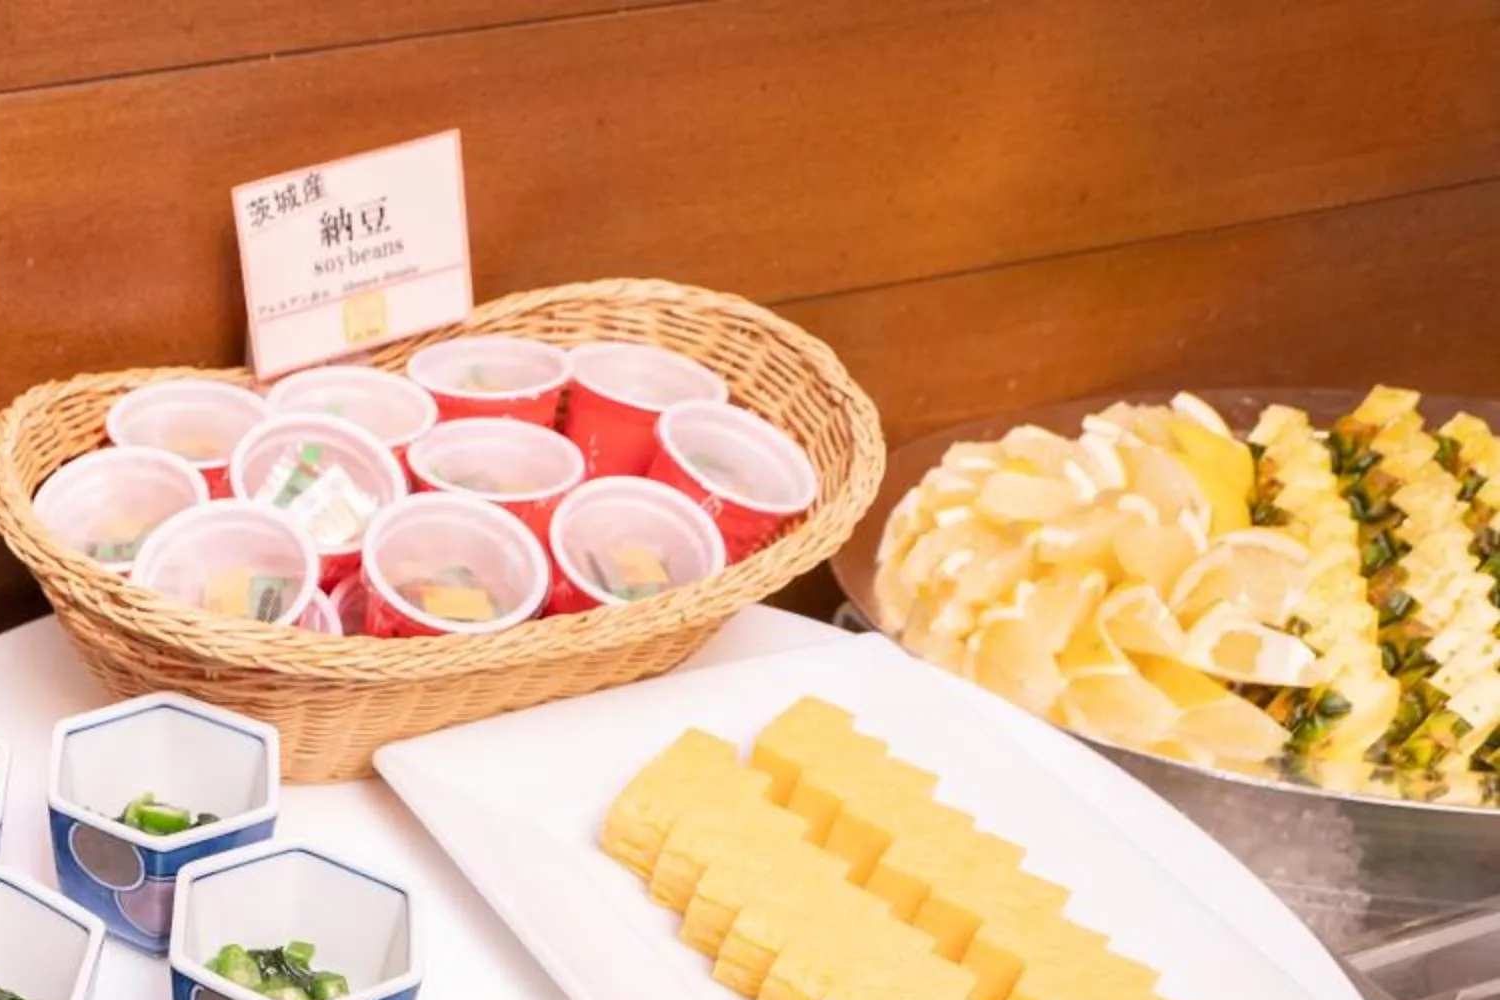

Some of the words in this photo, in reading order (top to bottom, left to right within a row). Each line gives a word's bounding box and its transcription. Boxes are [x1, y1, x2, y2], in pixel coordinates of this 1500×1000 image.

[245, 171, 325, 228] 茨城産
[319, 196, 393, 249] 納豆
[313, 237, 405, 277] soybeans
